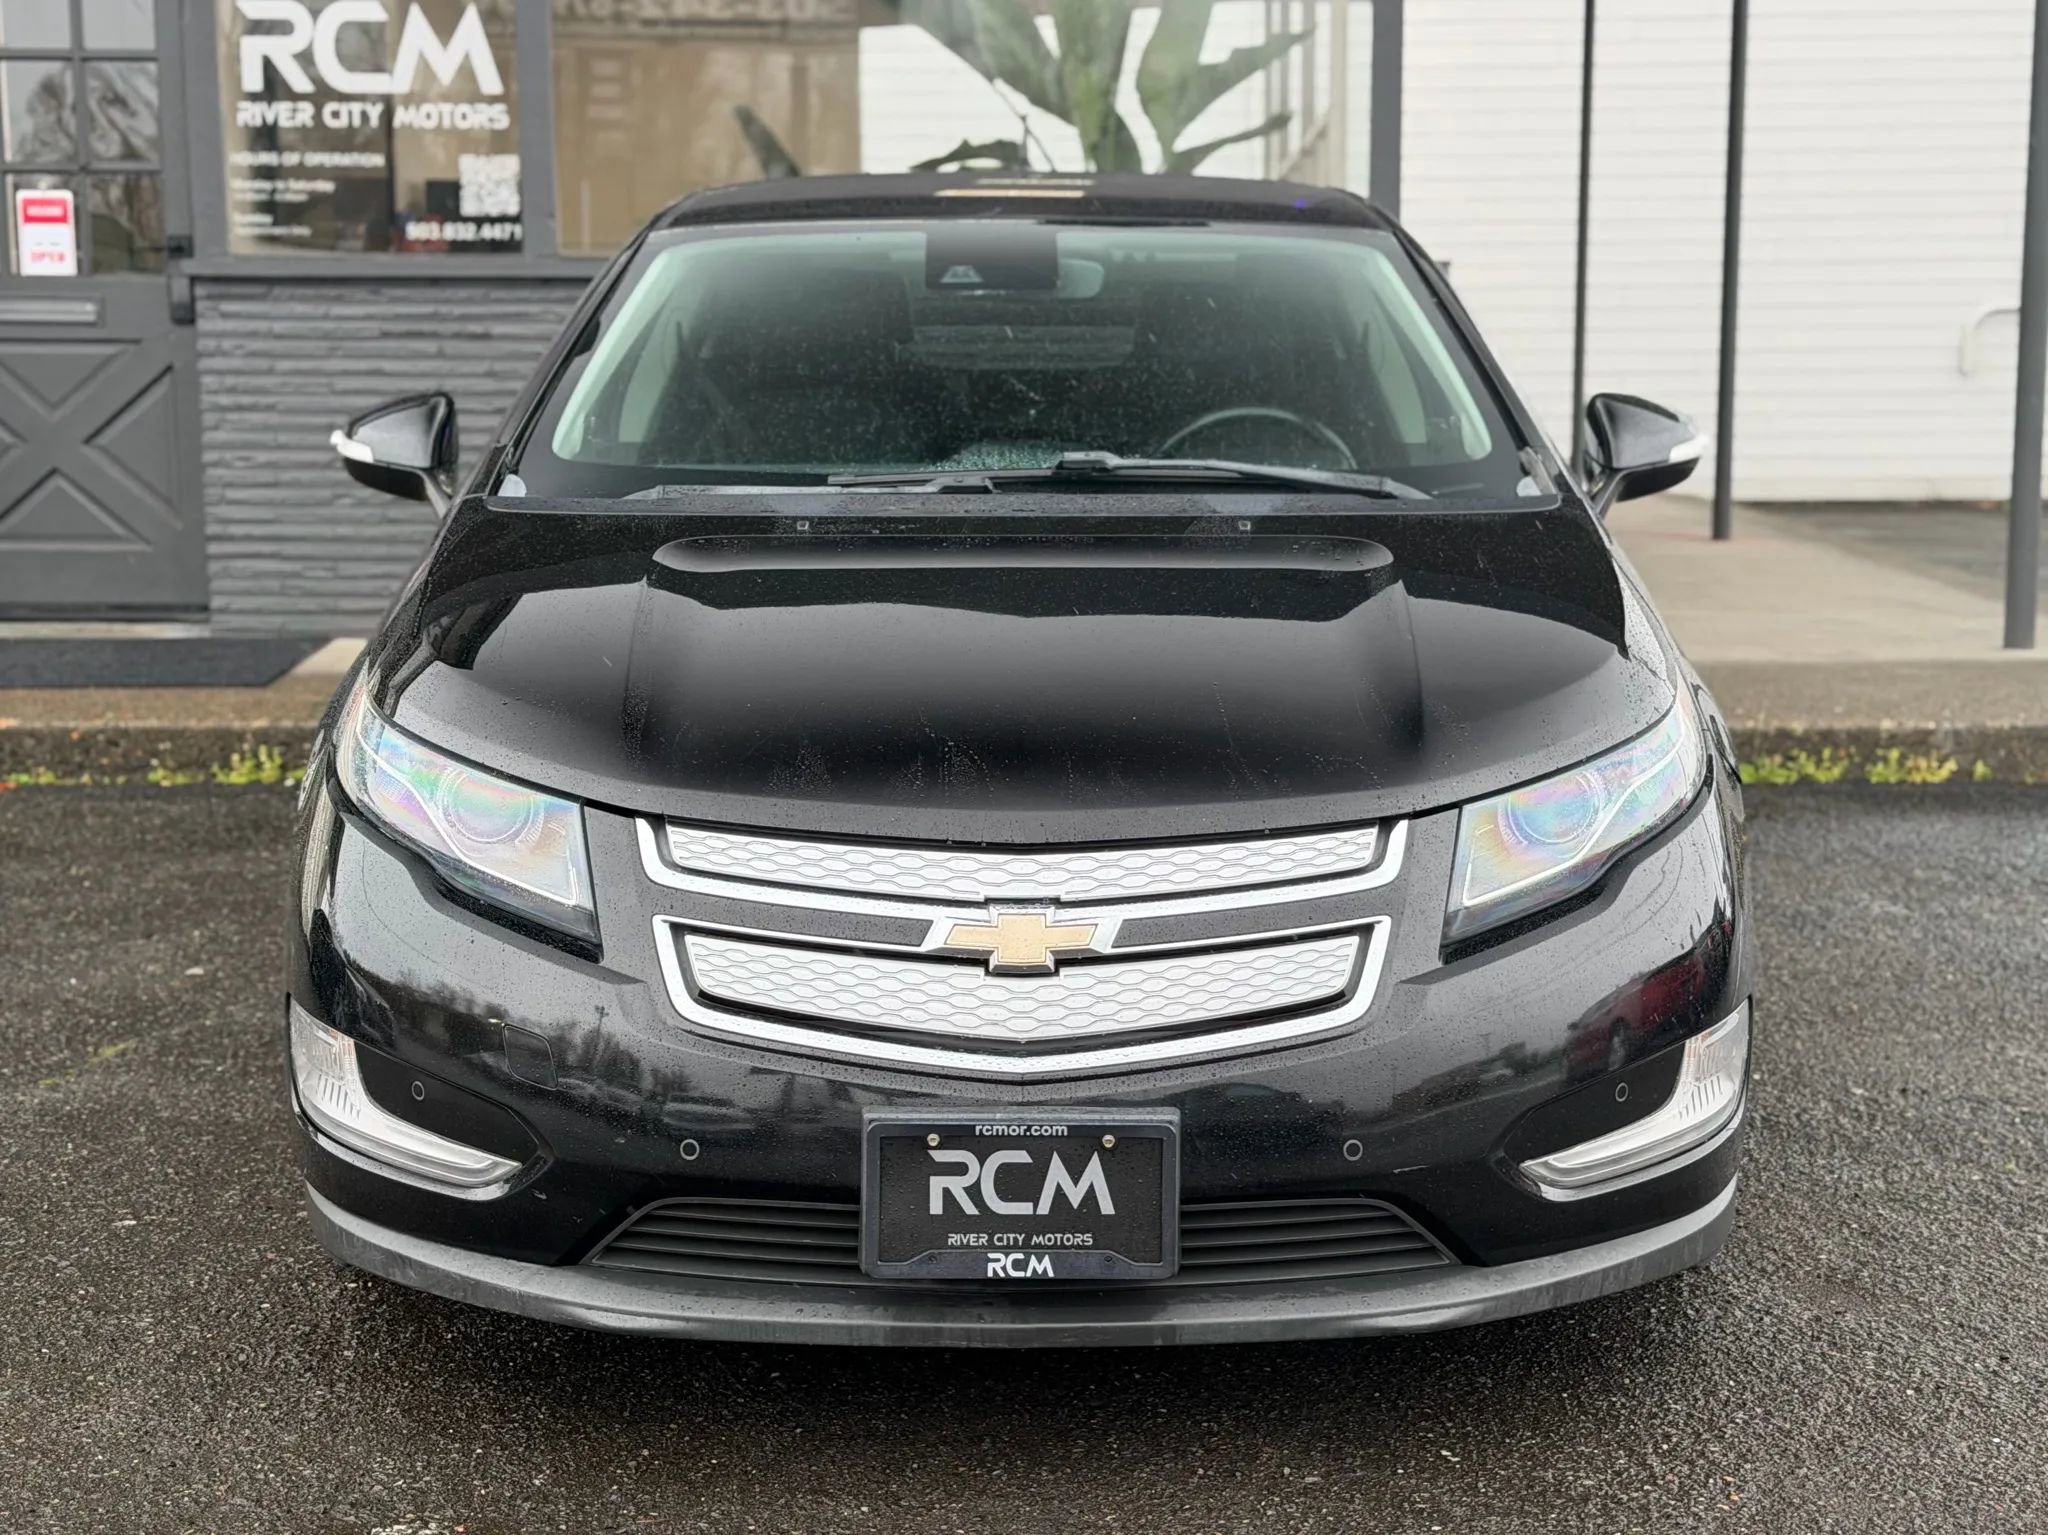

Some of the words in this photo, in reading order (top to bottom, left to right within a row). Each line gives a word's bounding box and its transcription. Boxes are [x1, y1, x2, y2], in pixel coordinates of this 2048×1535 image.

[236, 0, 504, 95] RCM
[236, 101, 315, 128] RIVER
[321, 102, 385, 129] CITY
[392, 103, 511, 130] MOTORS
[975, 1124, 1068, 1136] rcmor.com
[927, 1150, 1116, 1215] RCM
[947, 1233, 988, 1246] RIVER
[993, 1233, 1025, 1246] CITY
[1031, 1233, 1093, 1246] MOTORS
[986, 1253, 1055, 1278] RCM
